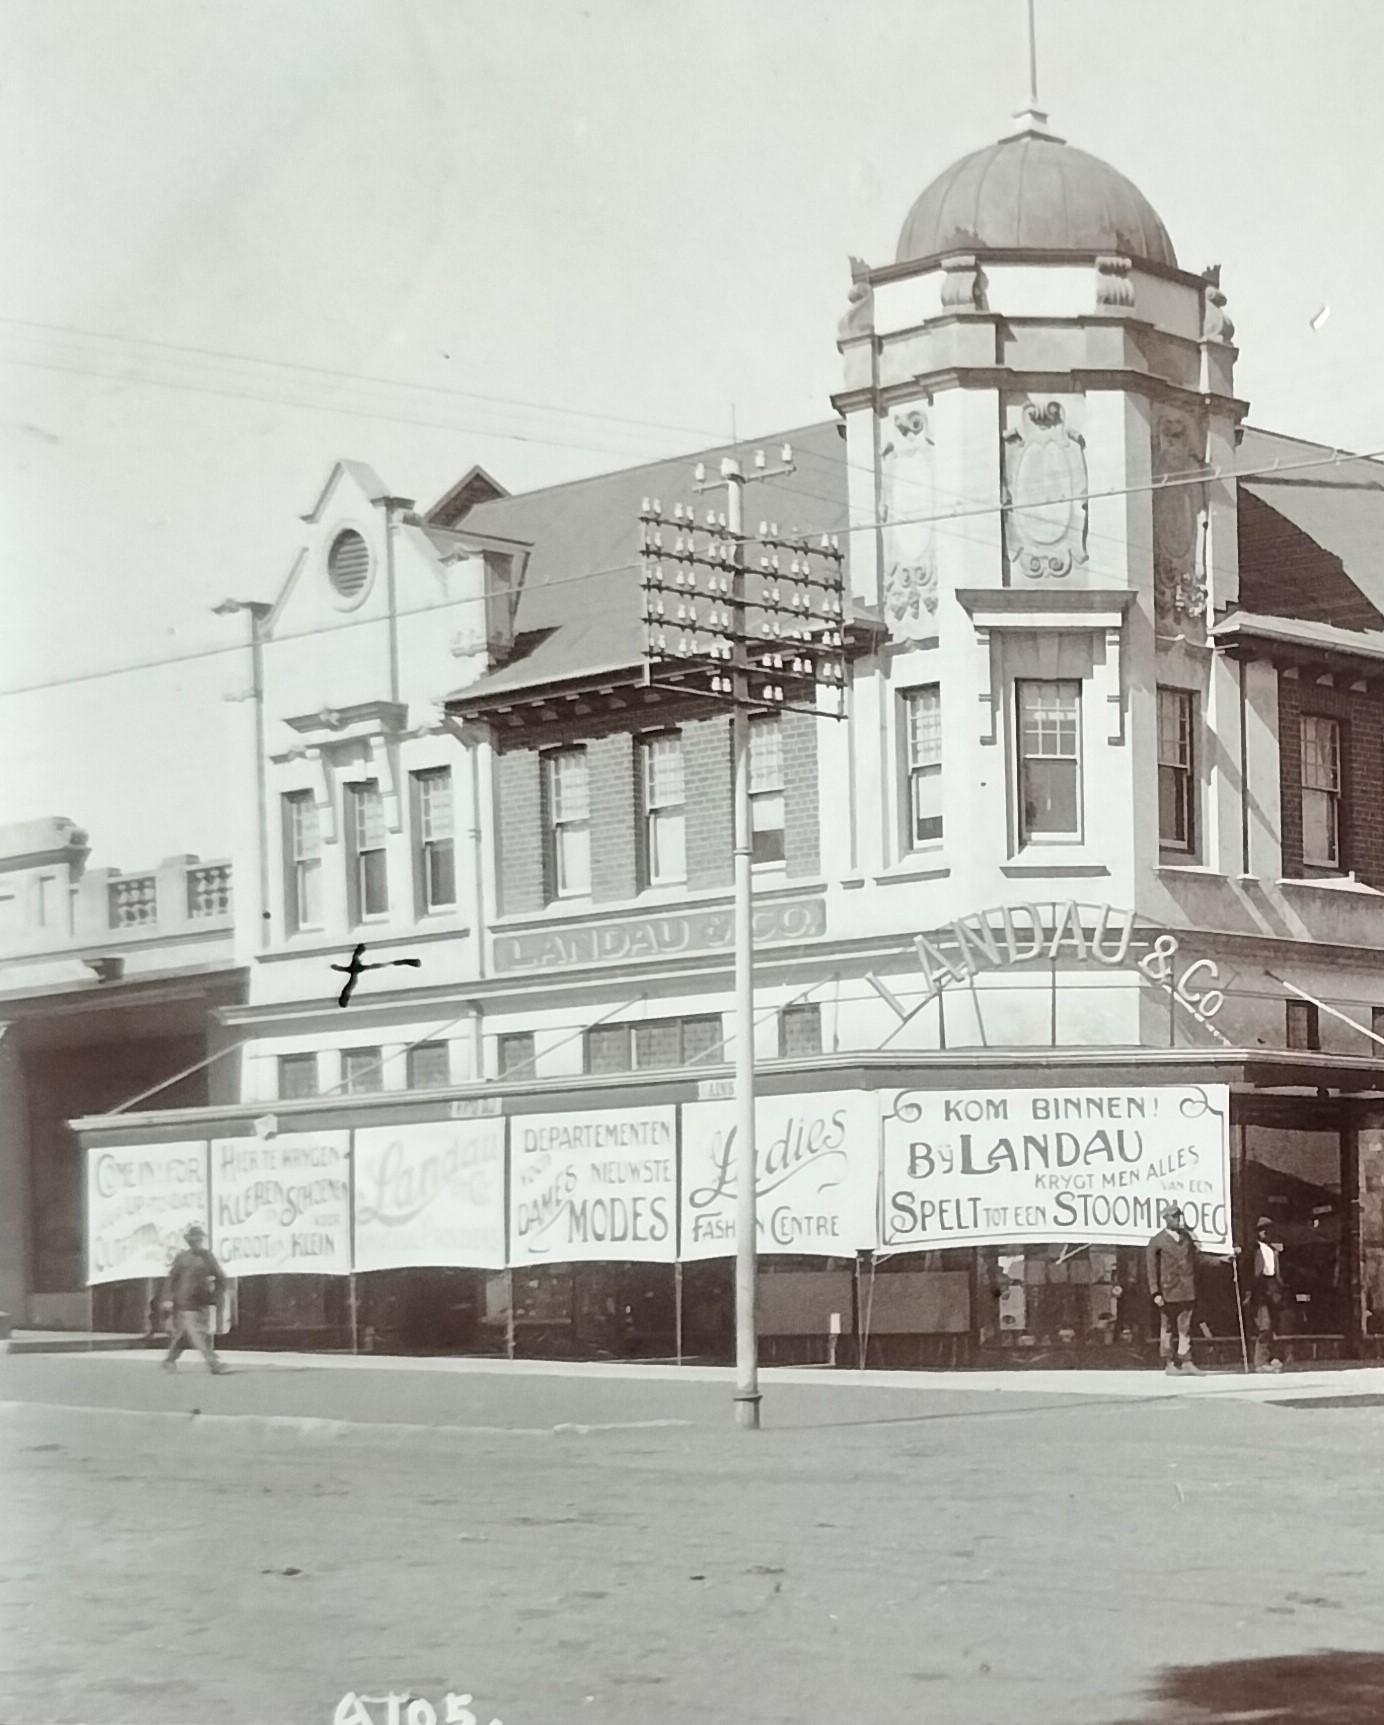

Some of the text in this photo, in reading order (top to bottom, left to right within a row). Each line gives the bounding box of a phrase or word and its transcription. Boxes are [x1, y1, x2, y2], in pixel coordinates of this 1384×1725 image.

[510, 920, 691, 970] LANDAU
[865, 899, 1136, 1023] LANDAU
[1138, 934, 1179, 980] &
[944, 1096, 1160, 1122] KOM BINNEN!
[524, 1120, 671, 1153] DEPARTEMENTEN
[959, 1128, 1143, 1175] LANDAU
[590, 1158, 673, 1184] NIEUWSTE
[1034, 1145, 1200, 1190] KRYGT MEN ALLES
[567, 1196, 669, 1243] MODES
[770, 1205, 840, 1246] CENTRE
[890, 1190, 1229, 1237] SPELT TOT EEN STOOMPOEG
